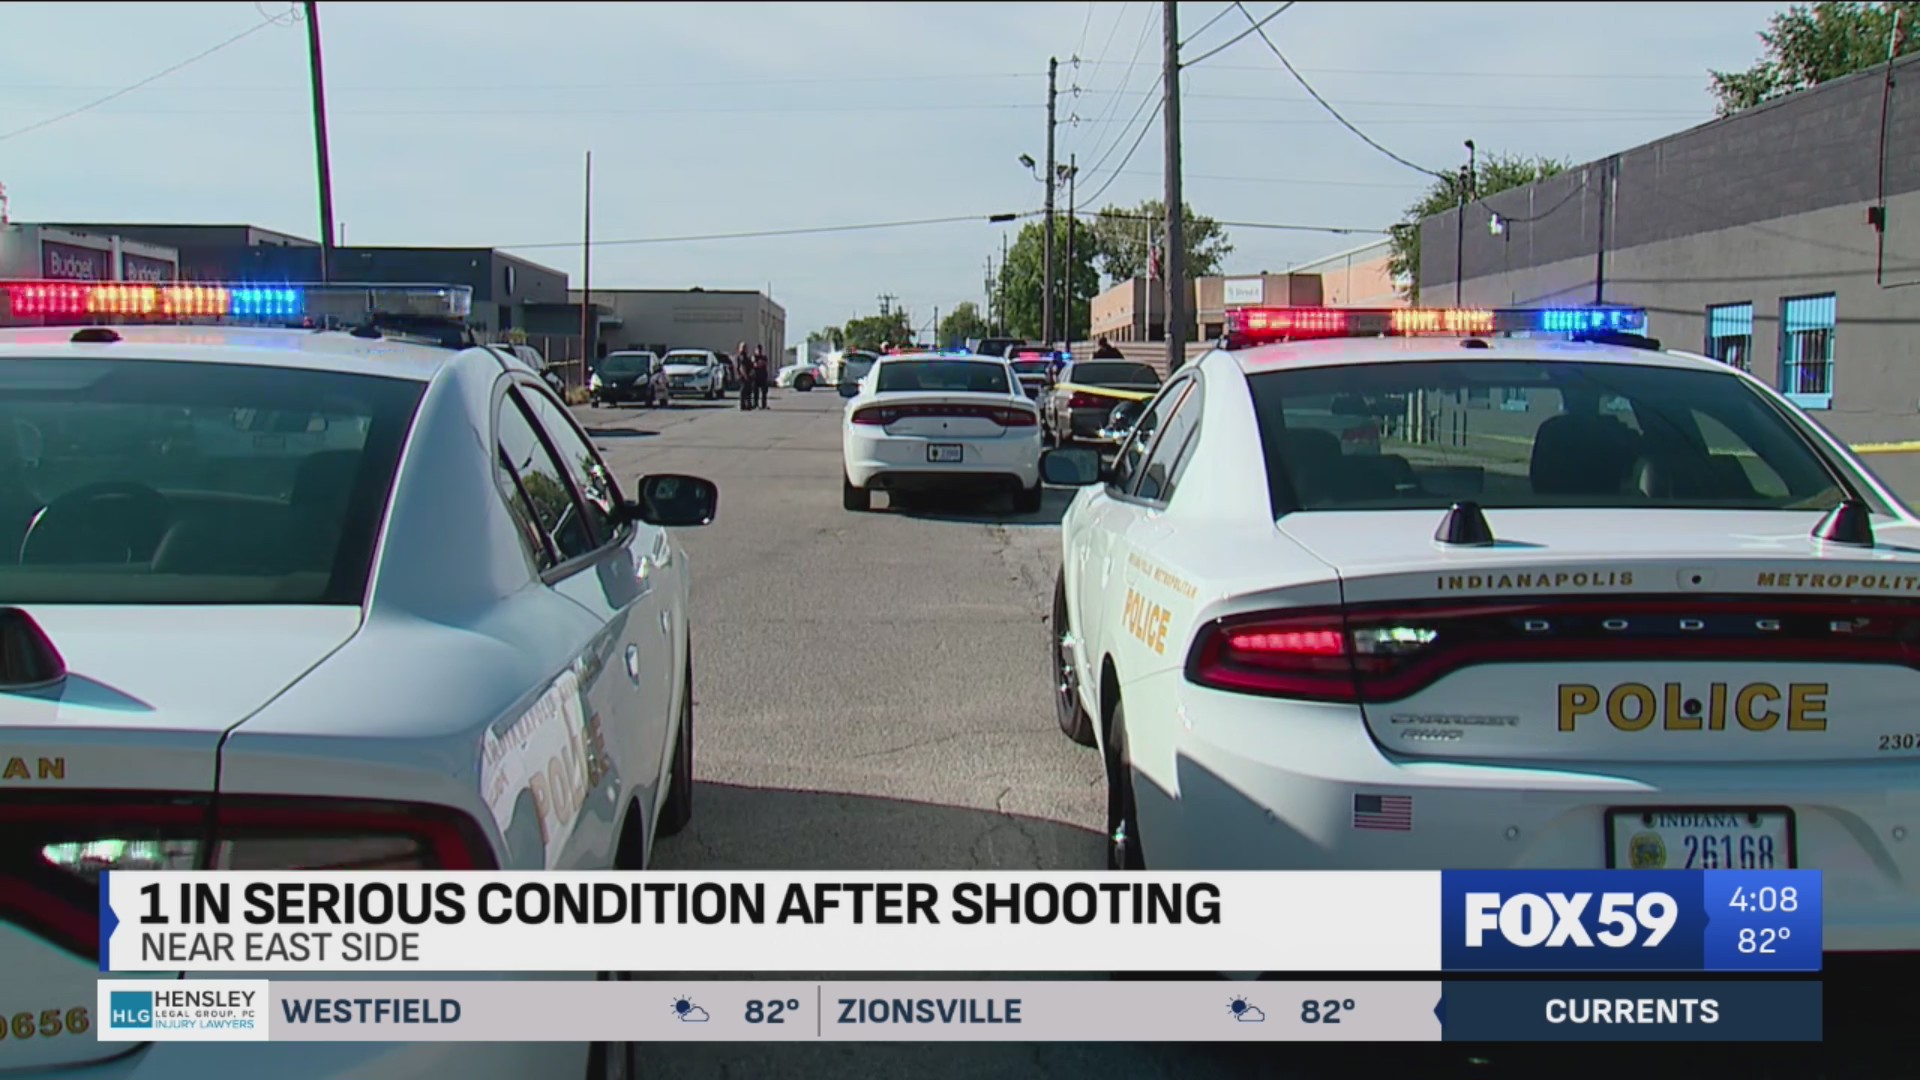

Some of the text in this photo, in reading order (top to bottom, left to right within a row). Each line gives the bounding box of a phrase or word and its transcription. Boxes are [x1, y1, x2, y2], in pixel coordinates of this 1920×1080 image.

[50, 250, 94, 281] Budget
[1436, 571, 1634, 590] INDIANAPOLIS
[1122, 588, 1171, 655] POLICE
[1524, 618, 1852, 633] DODGE
[1557, 682, 1829, 732] POLICE
[2, 757, 65, 780] AN
[1658, 813, 1739, 828] INDIANA
[1684, 834, 1774, 869] 26168
